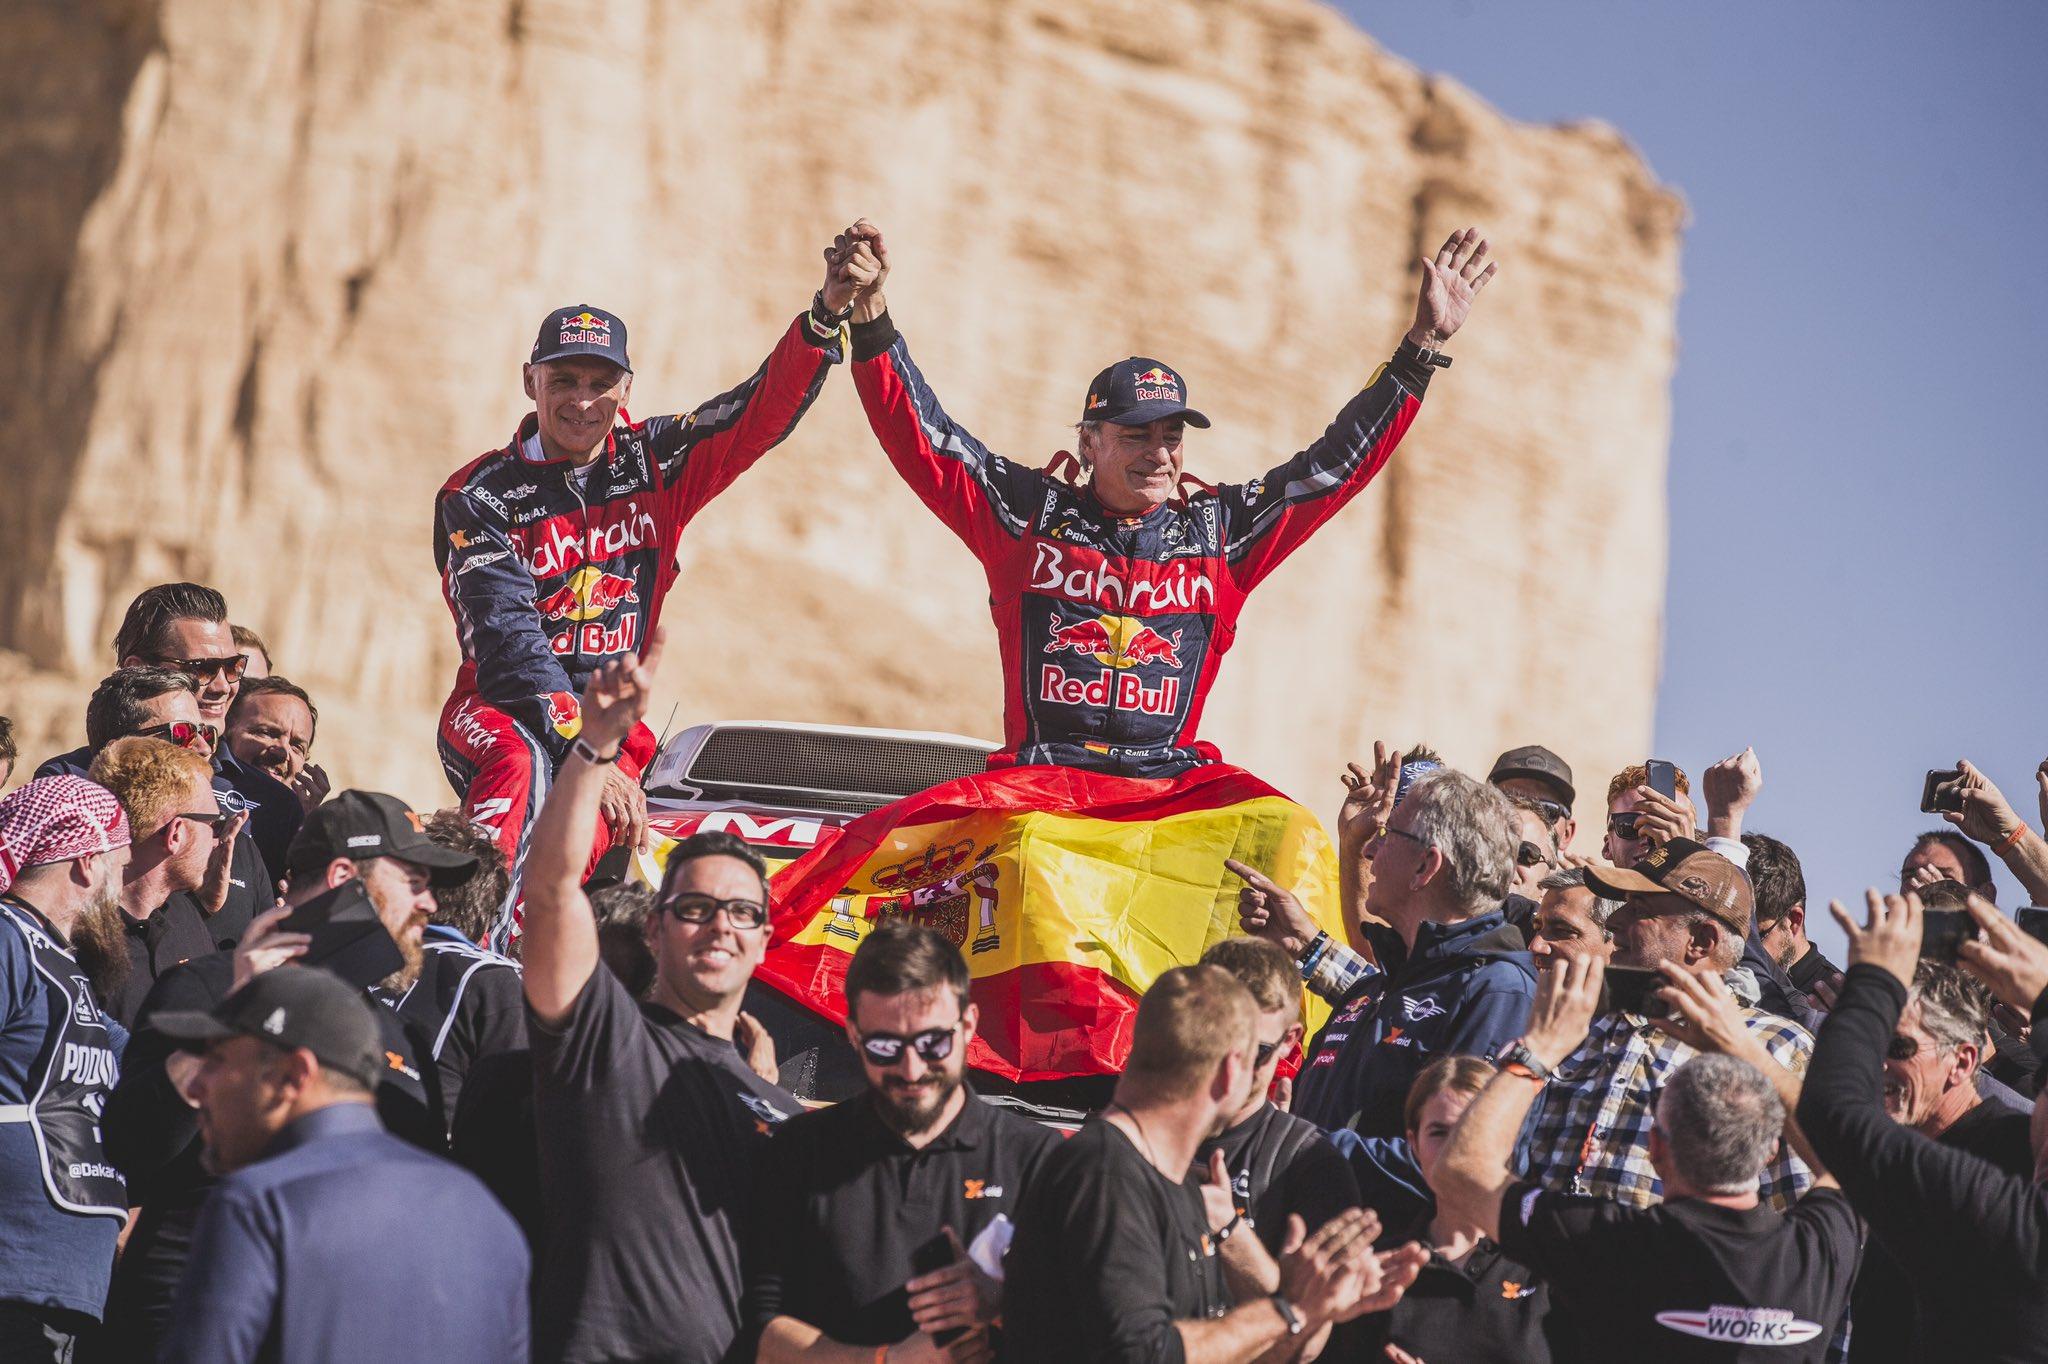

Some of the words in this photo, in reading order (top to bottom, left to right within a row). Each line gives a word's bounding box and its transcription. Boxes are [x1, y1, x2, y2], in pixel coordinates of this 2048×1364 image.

[560, 330, 586, 344] Red
[587, 333, 611, 347] Bull
[1136, 387, 1161, 401] Red
[1162, 387, 1181, 403] Bull
[1031, 542, 1214, 610] Bahrain
[581, 612, 638, 657] Bull
[1040, 664, 1113, 708] Red
[1115, 671, 1180, 716] Bull
[227, 796, 244, 808] MINI
[1708, 1318, 1788, 1341] WORKS
